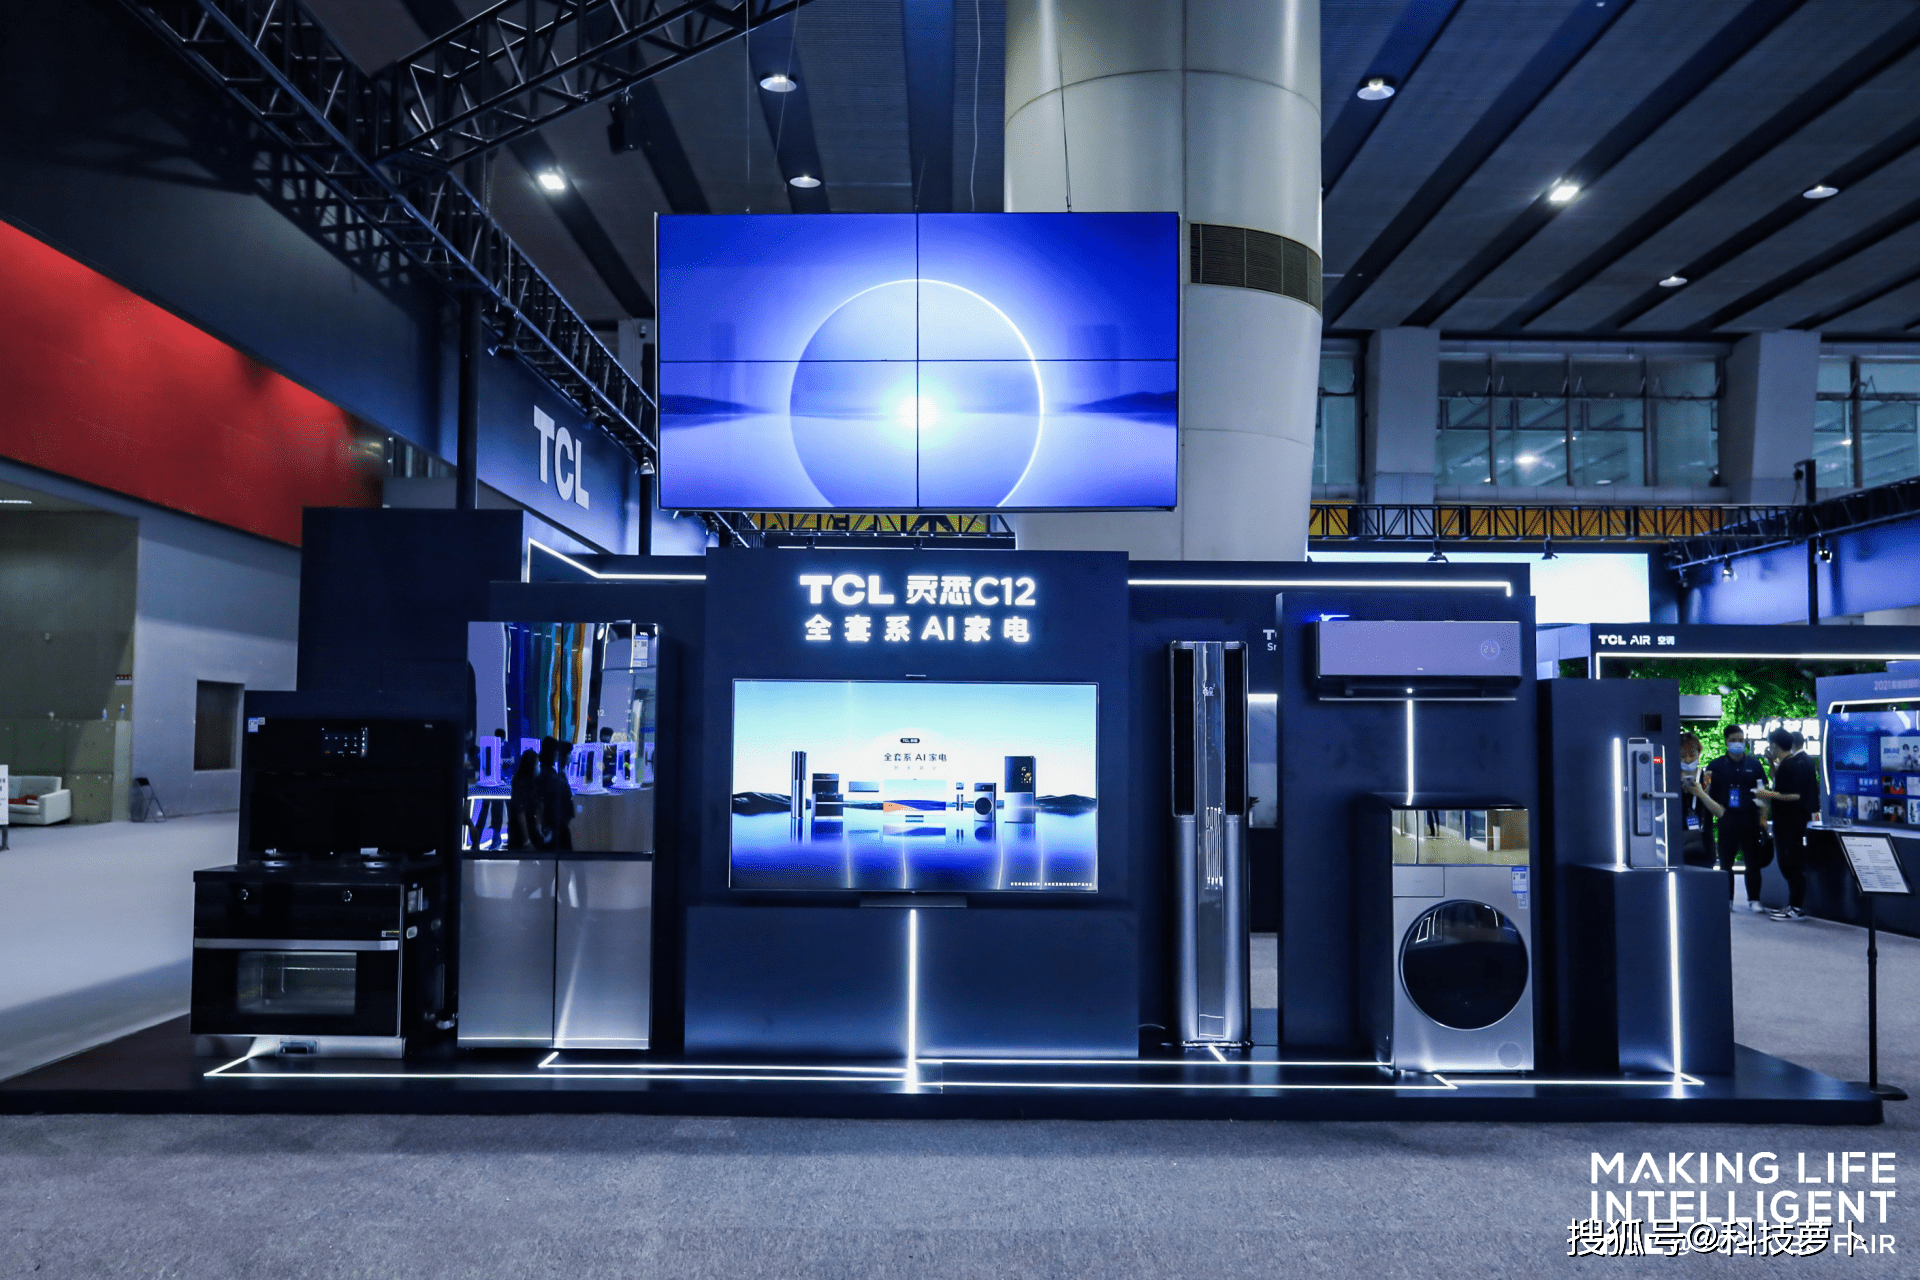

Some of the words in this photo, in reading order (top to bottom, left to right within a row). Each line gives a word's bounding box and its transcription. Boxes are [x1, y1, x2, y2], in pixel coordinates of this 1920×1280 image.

[534, 405, 590, 510] TCL
[799, 574, 895, 605] TCL
[1598, 634, 1627, 646] TCL
[1629, 634, 1652, 646] AIR
[1657, 635, 1676, 646] 空调
